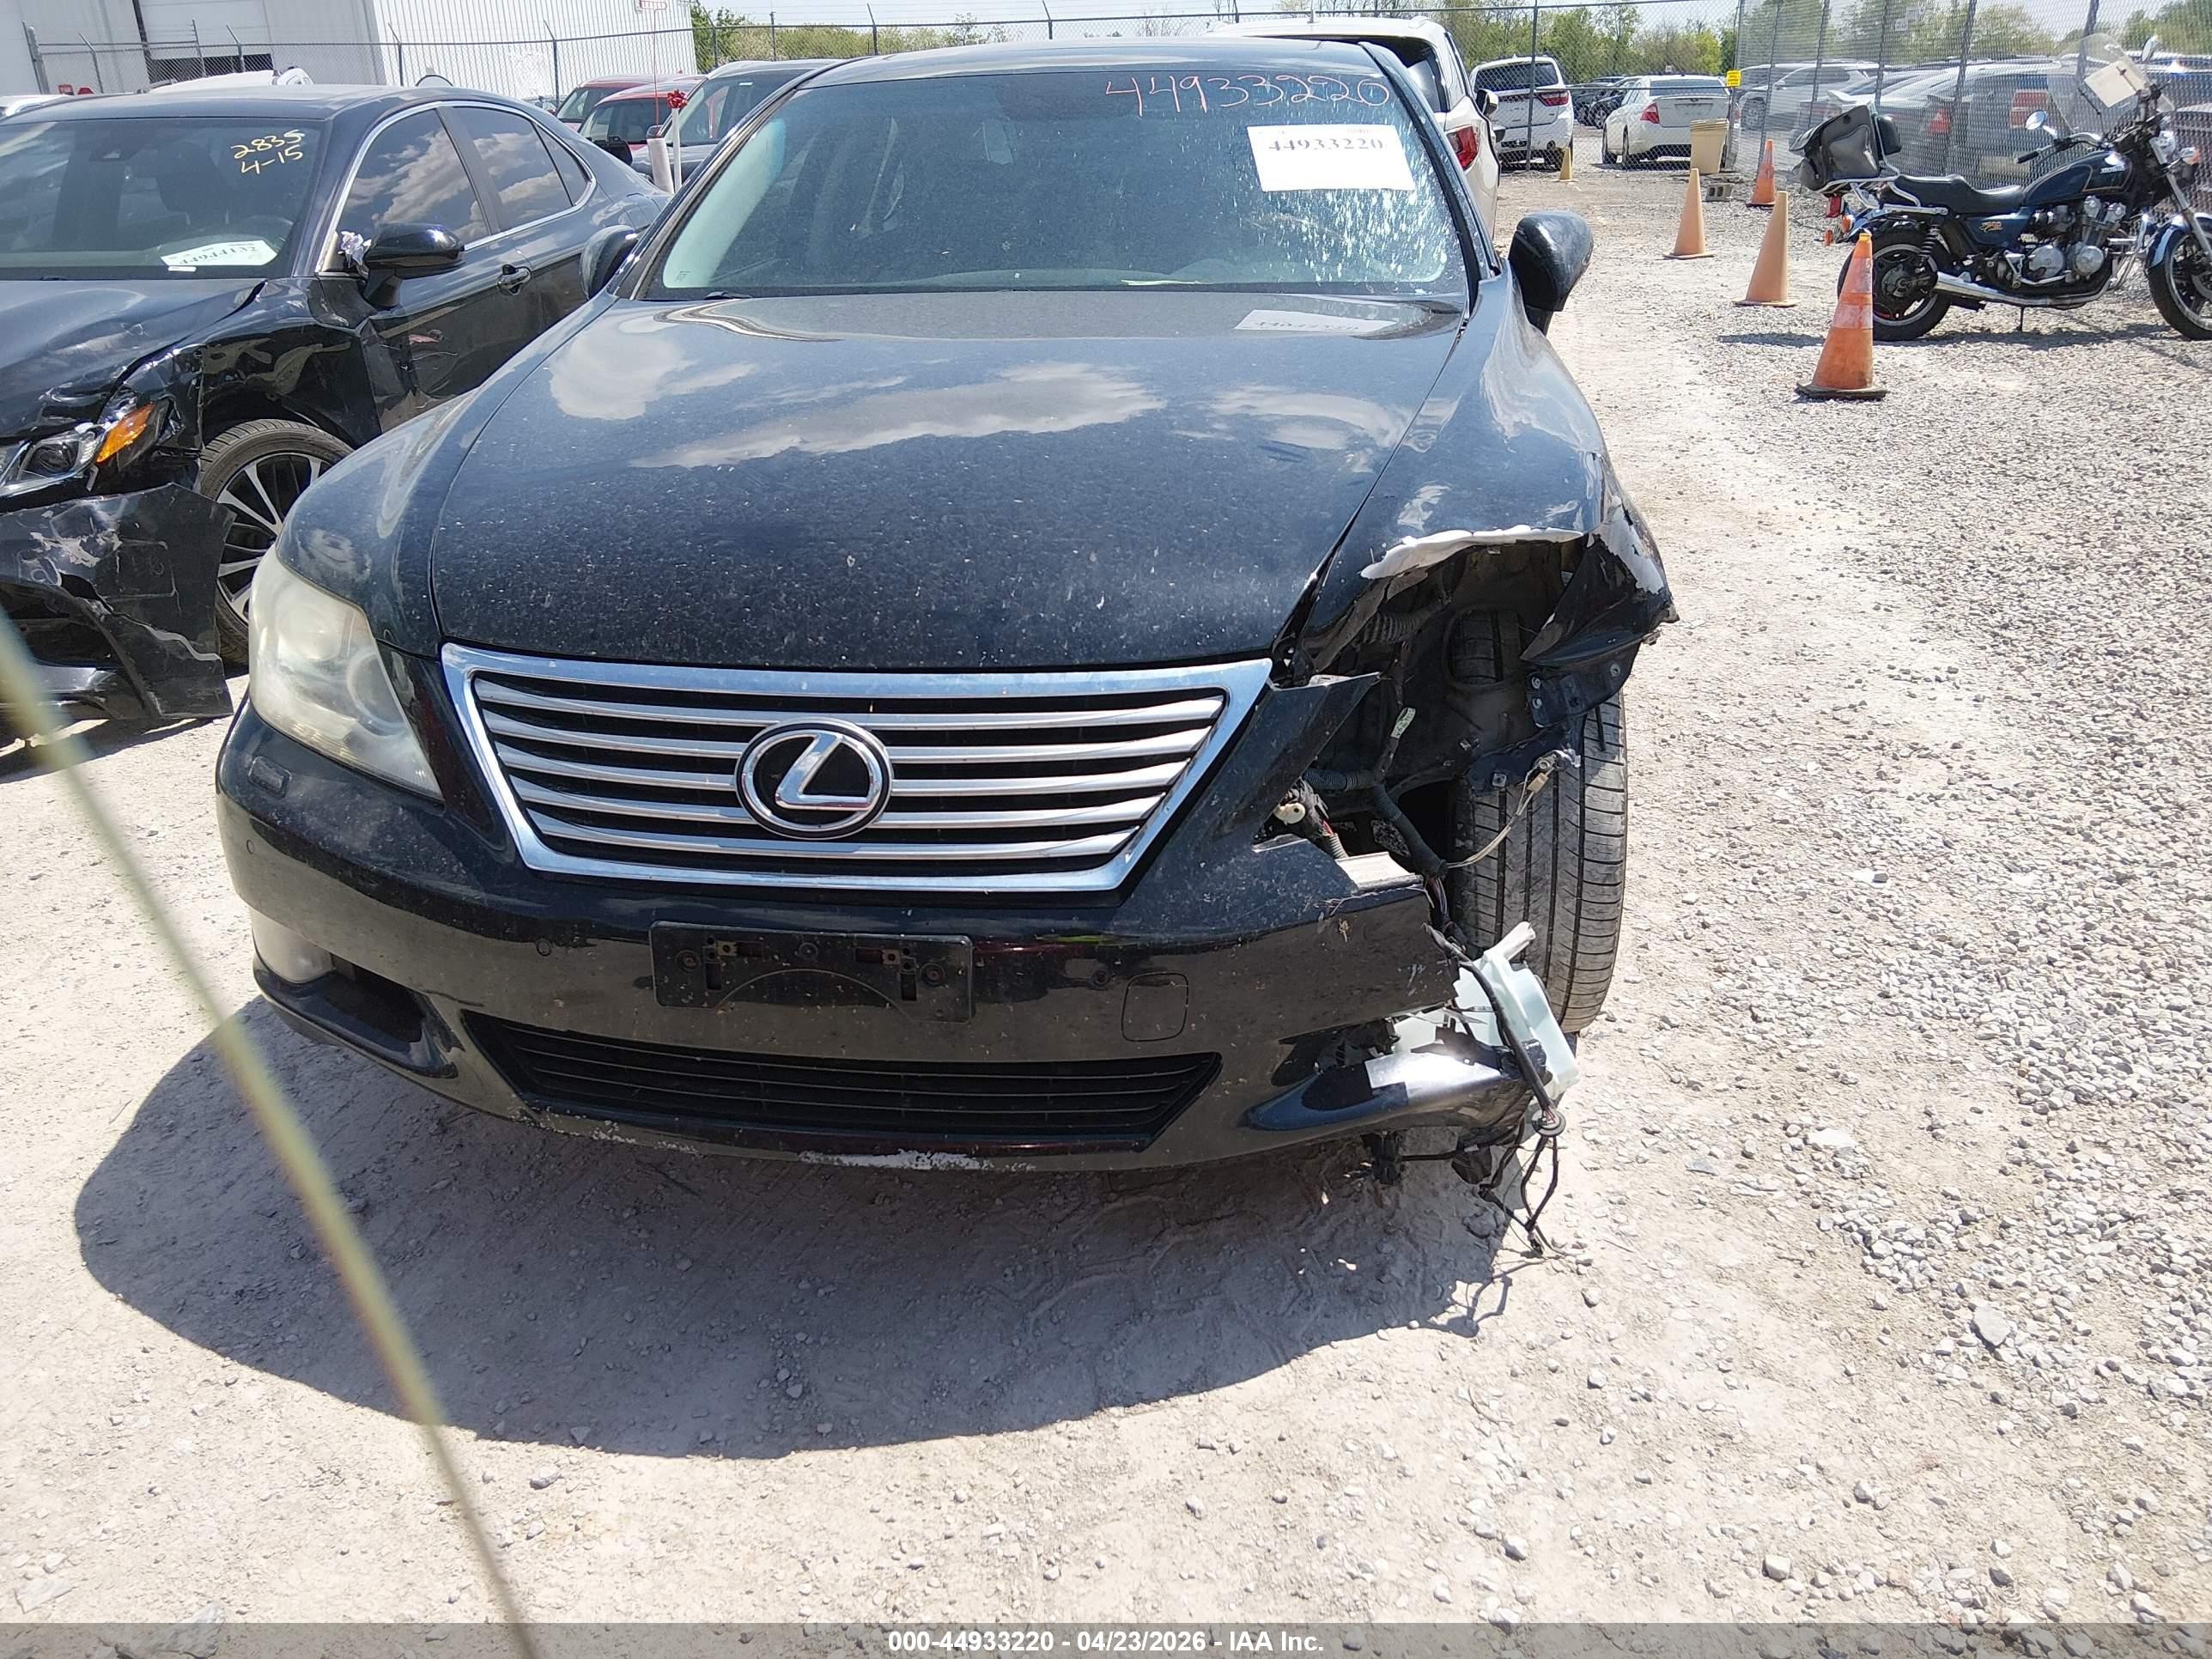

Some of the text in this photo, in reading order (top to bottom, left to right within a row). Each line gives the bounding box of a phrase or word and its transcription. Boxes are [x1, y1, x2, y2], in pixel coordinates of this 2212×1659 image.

[1105, 75, 1390, 118] 44933220
[229, 128, 306, 160] 2835
[240, 143, 304, 175] 4-15
[1268, 137, 1384, 151] 44933220
